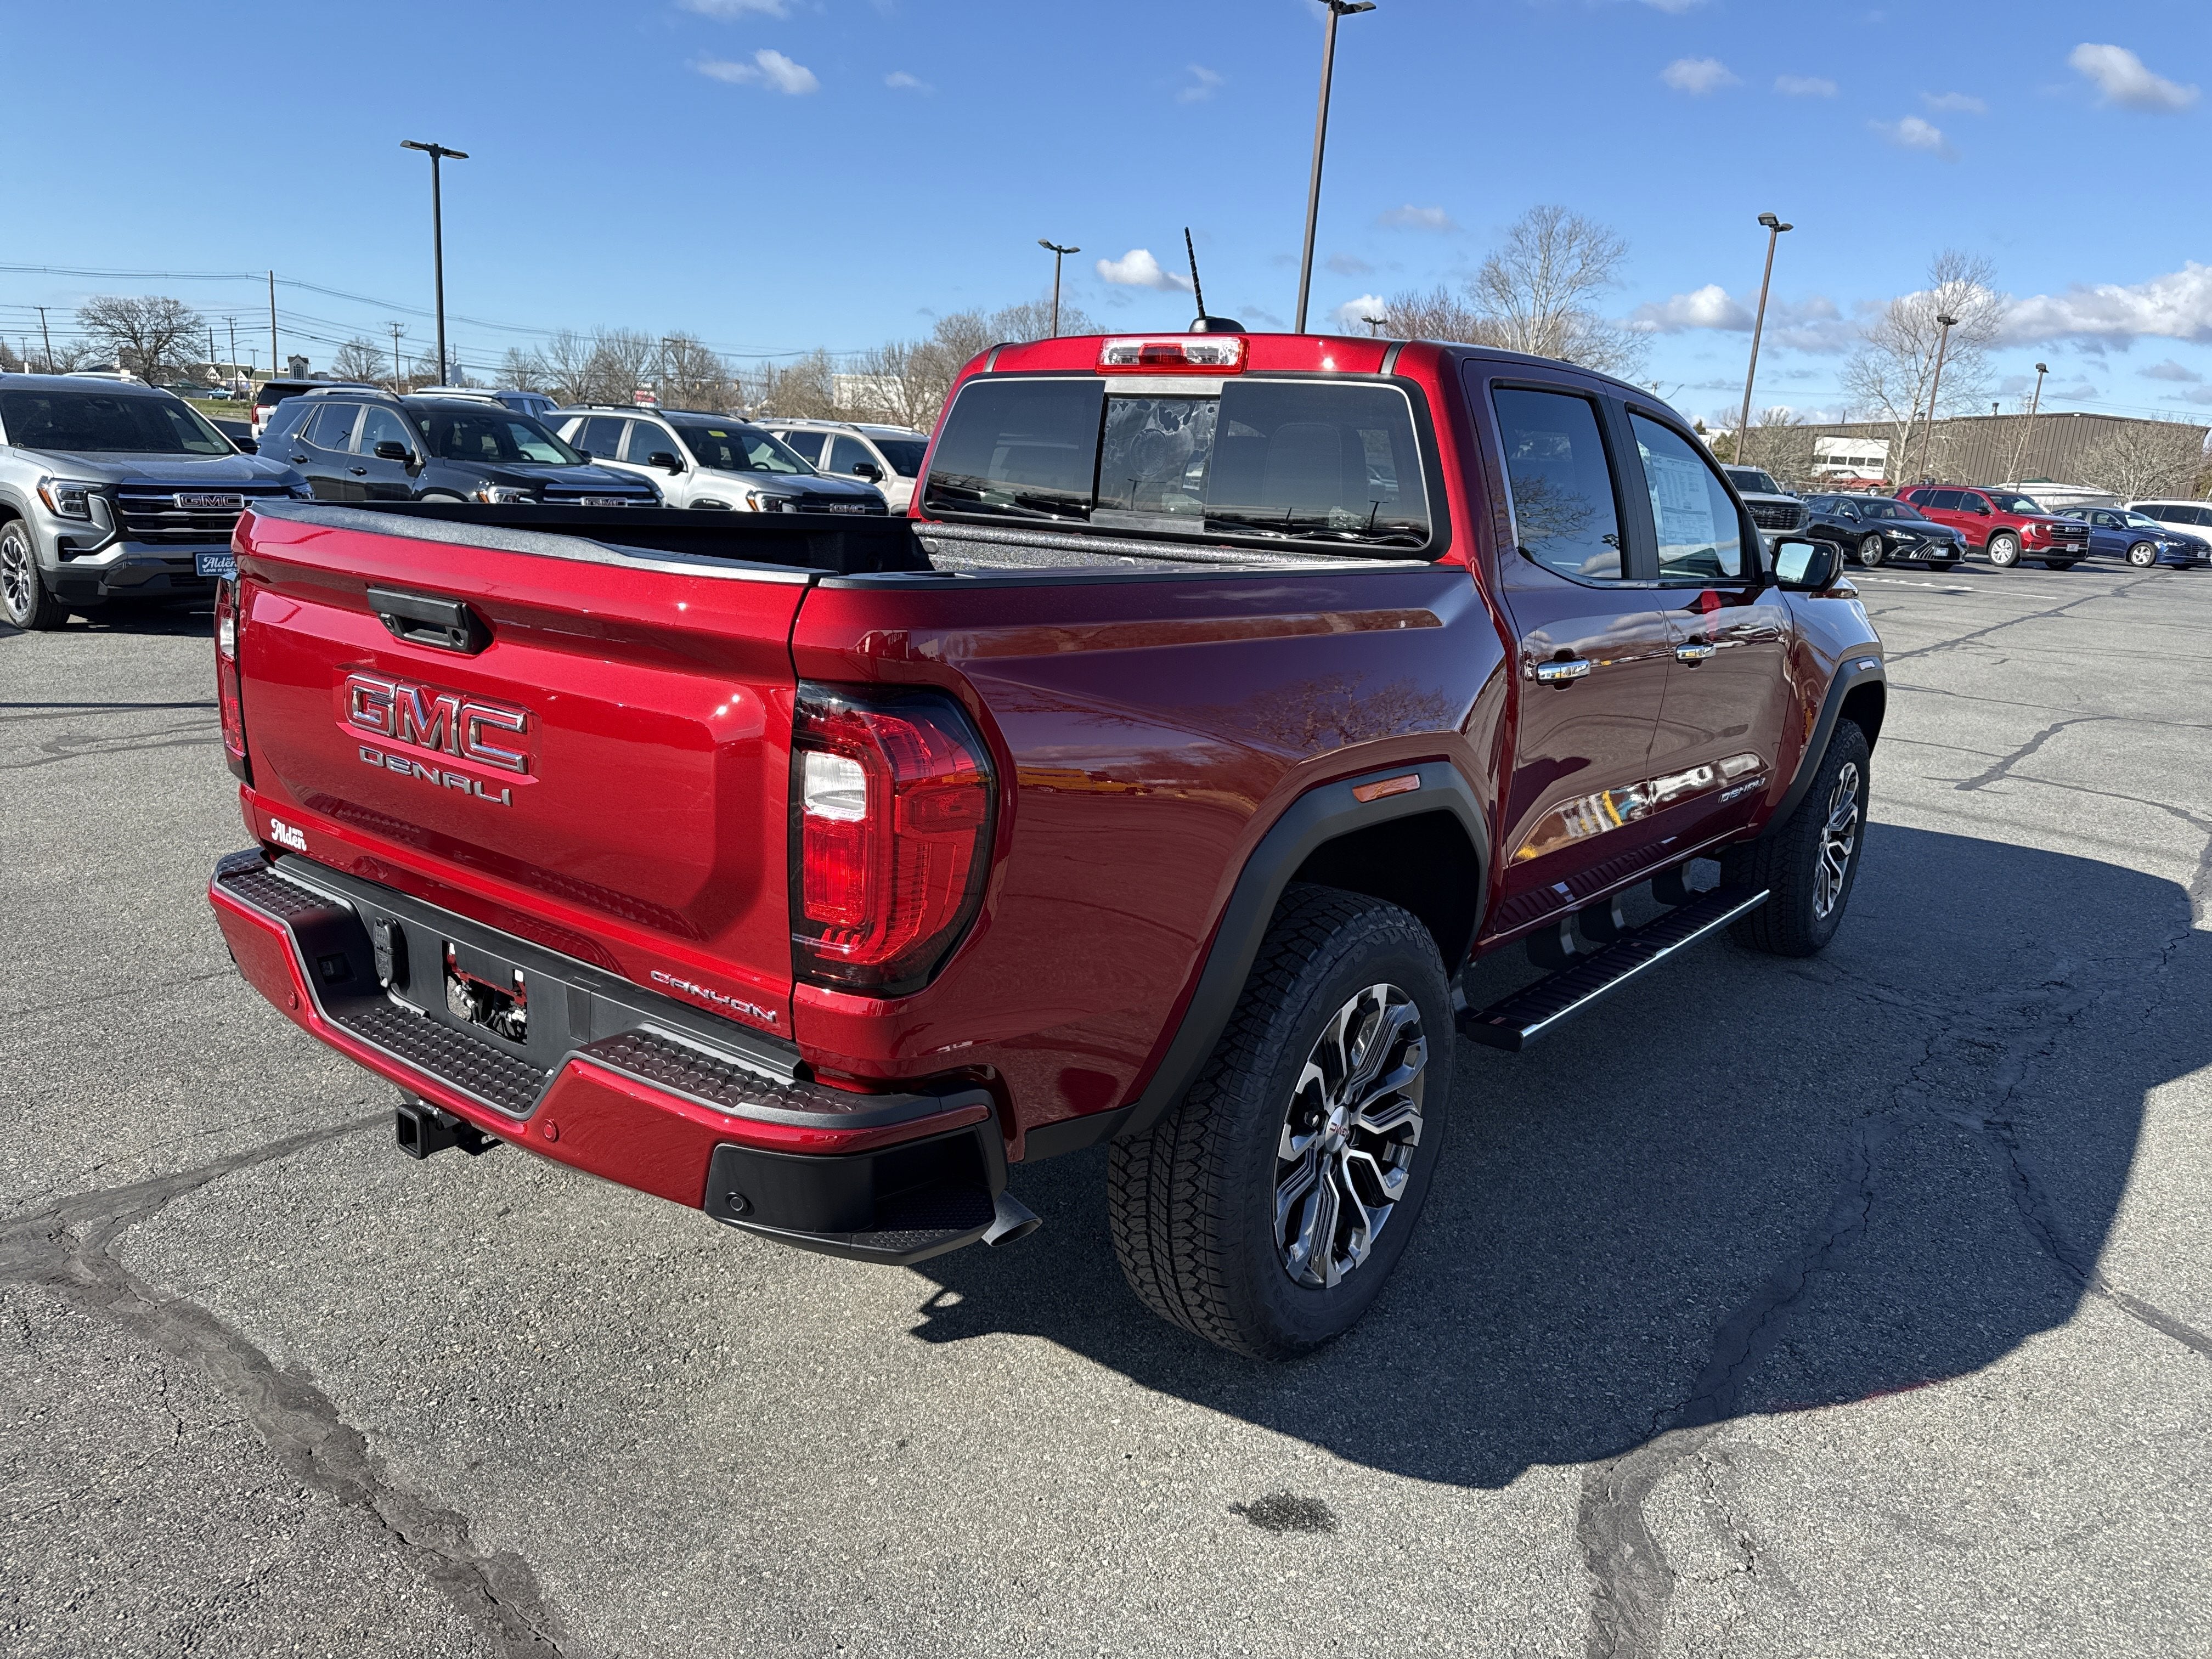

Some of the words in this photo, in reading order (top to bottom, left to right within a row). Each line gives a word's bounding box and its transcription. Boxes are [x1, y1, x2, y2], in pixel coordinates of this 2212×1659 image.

[180, 495, 242, 506] GMC
[833, 504, 865, 514] GMC
[202, 556, 237, 568] Alden
[345, 674, 530, 775] GMC
[359, 744, 513, 808] DENALI
[1718, 776, 1766, 804] DENALI
[270, 818, 307, 851] Alden
[650, 969, 777, 1024] CANYON
[1329, 1121, 1347, 1137] GMC
